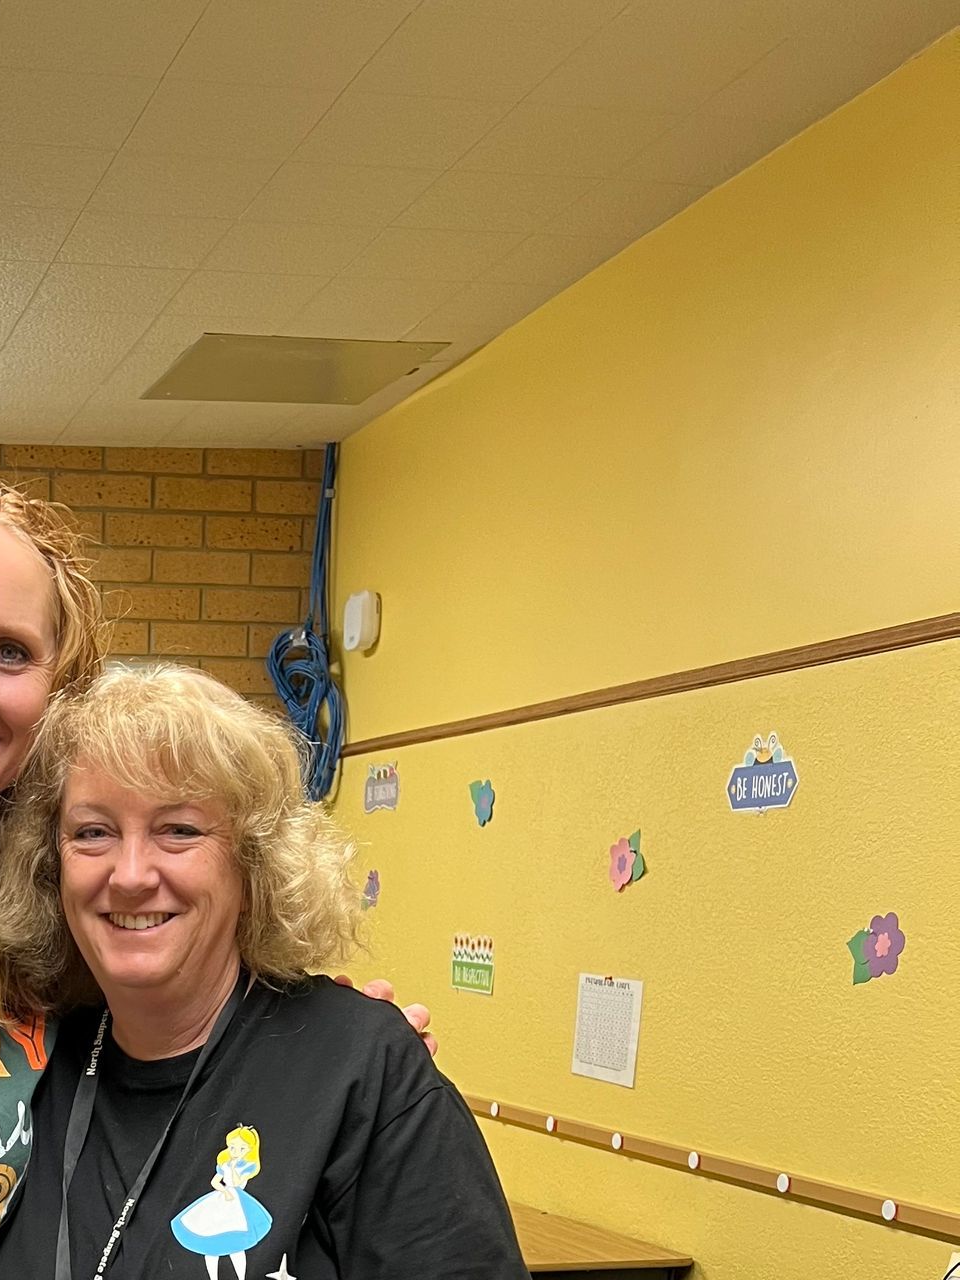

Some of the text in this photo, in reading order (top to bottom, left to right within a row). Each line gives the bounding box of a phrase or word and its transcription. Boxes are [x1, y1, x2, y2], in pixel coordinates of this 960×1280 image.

[737, 772, 789, 801] BE HONEST
[86, 1045, 103, 1076] North
[112, 1198, 136, 1231] North
[97, 1229, 121, 1273] Sanpete
